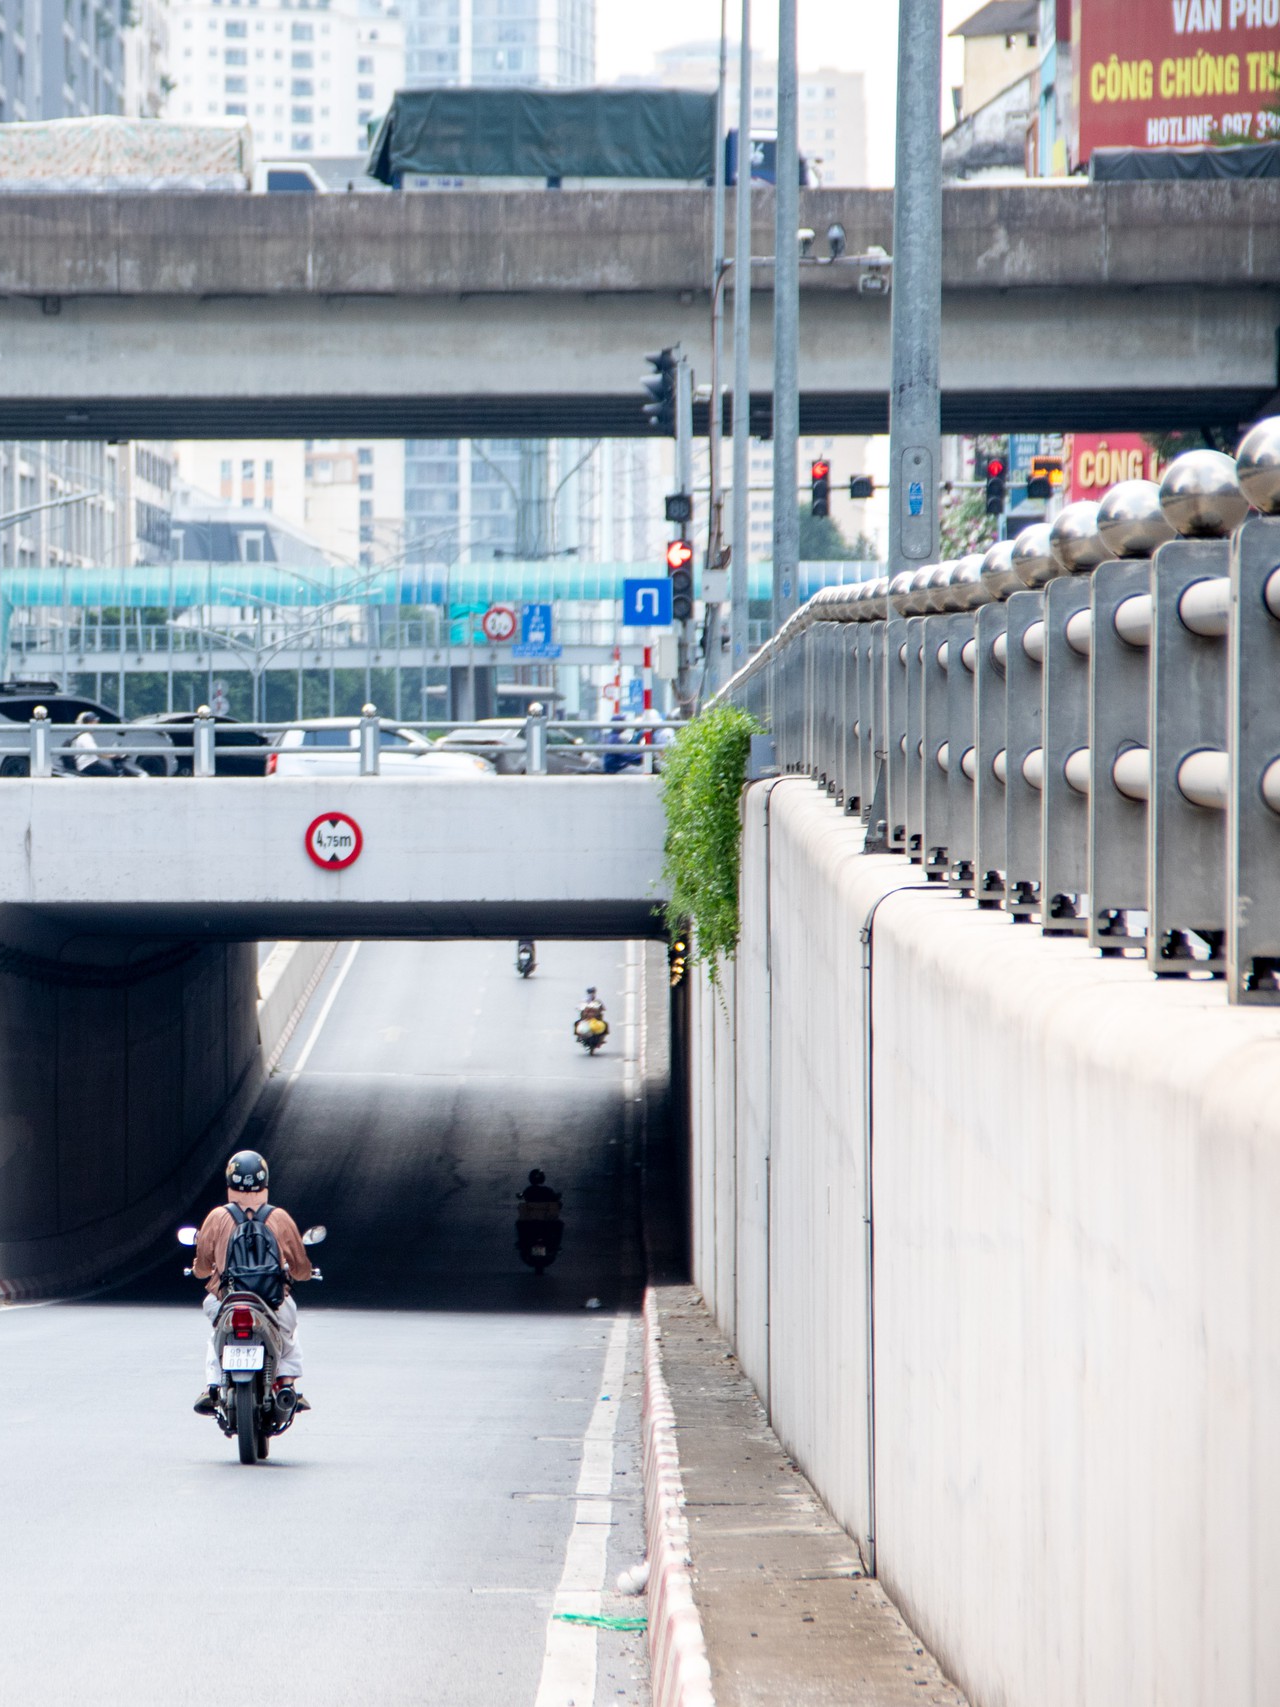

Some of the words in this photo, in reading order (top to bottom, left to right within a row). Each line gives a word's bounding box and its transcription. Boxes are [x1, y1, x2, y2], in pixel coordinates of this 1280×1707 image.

[1091, 54, 1153, 102] CÔNG
[1246, 50, 1280, 94] TH
[1079, 440, 1144, 488] CÔNG
[316, 830, 352, 849] 4,75m
